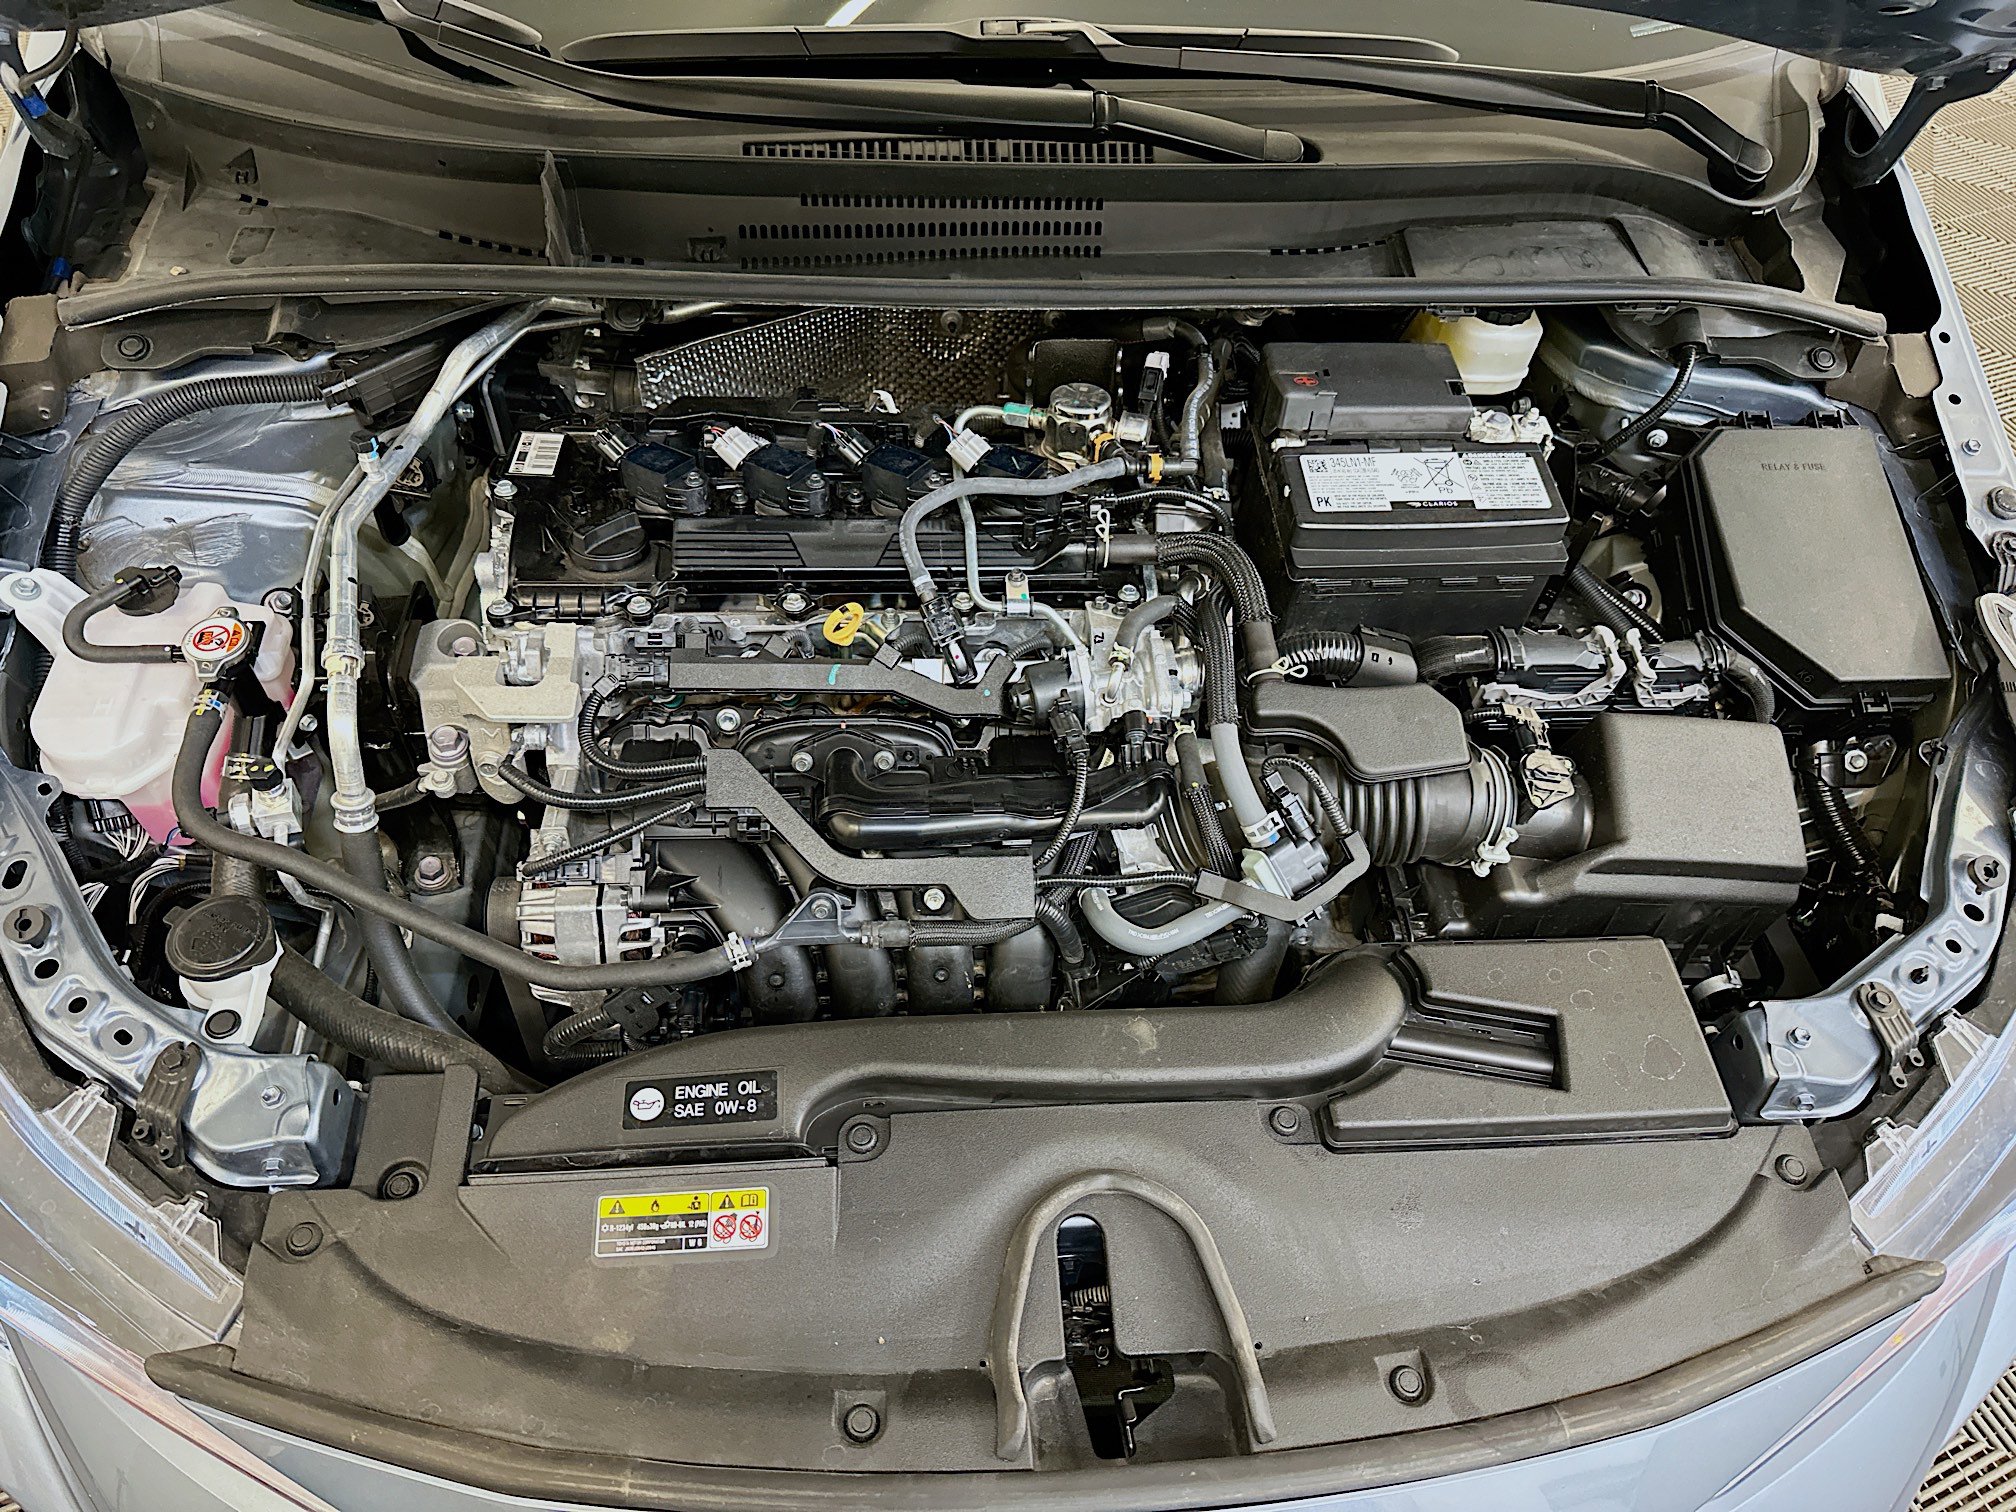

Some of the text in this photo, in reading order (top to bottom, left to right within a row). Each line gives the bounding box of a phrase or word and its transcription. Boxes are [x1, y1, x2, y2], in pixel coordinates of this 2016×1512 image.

[1329, 456, 1377, 468] 345LN1-MF
[1761, 463, 1826, 471] RELAY & FUSE
[1438, 486, 1454, 494] Pb
[1316, 496, 1332, 507] PK
[674, 1080, 762, 1100] ENGINE OIL
[673, 1098, 757, 1118] SAE 0W-8
